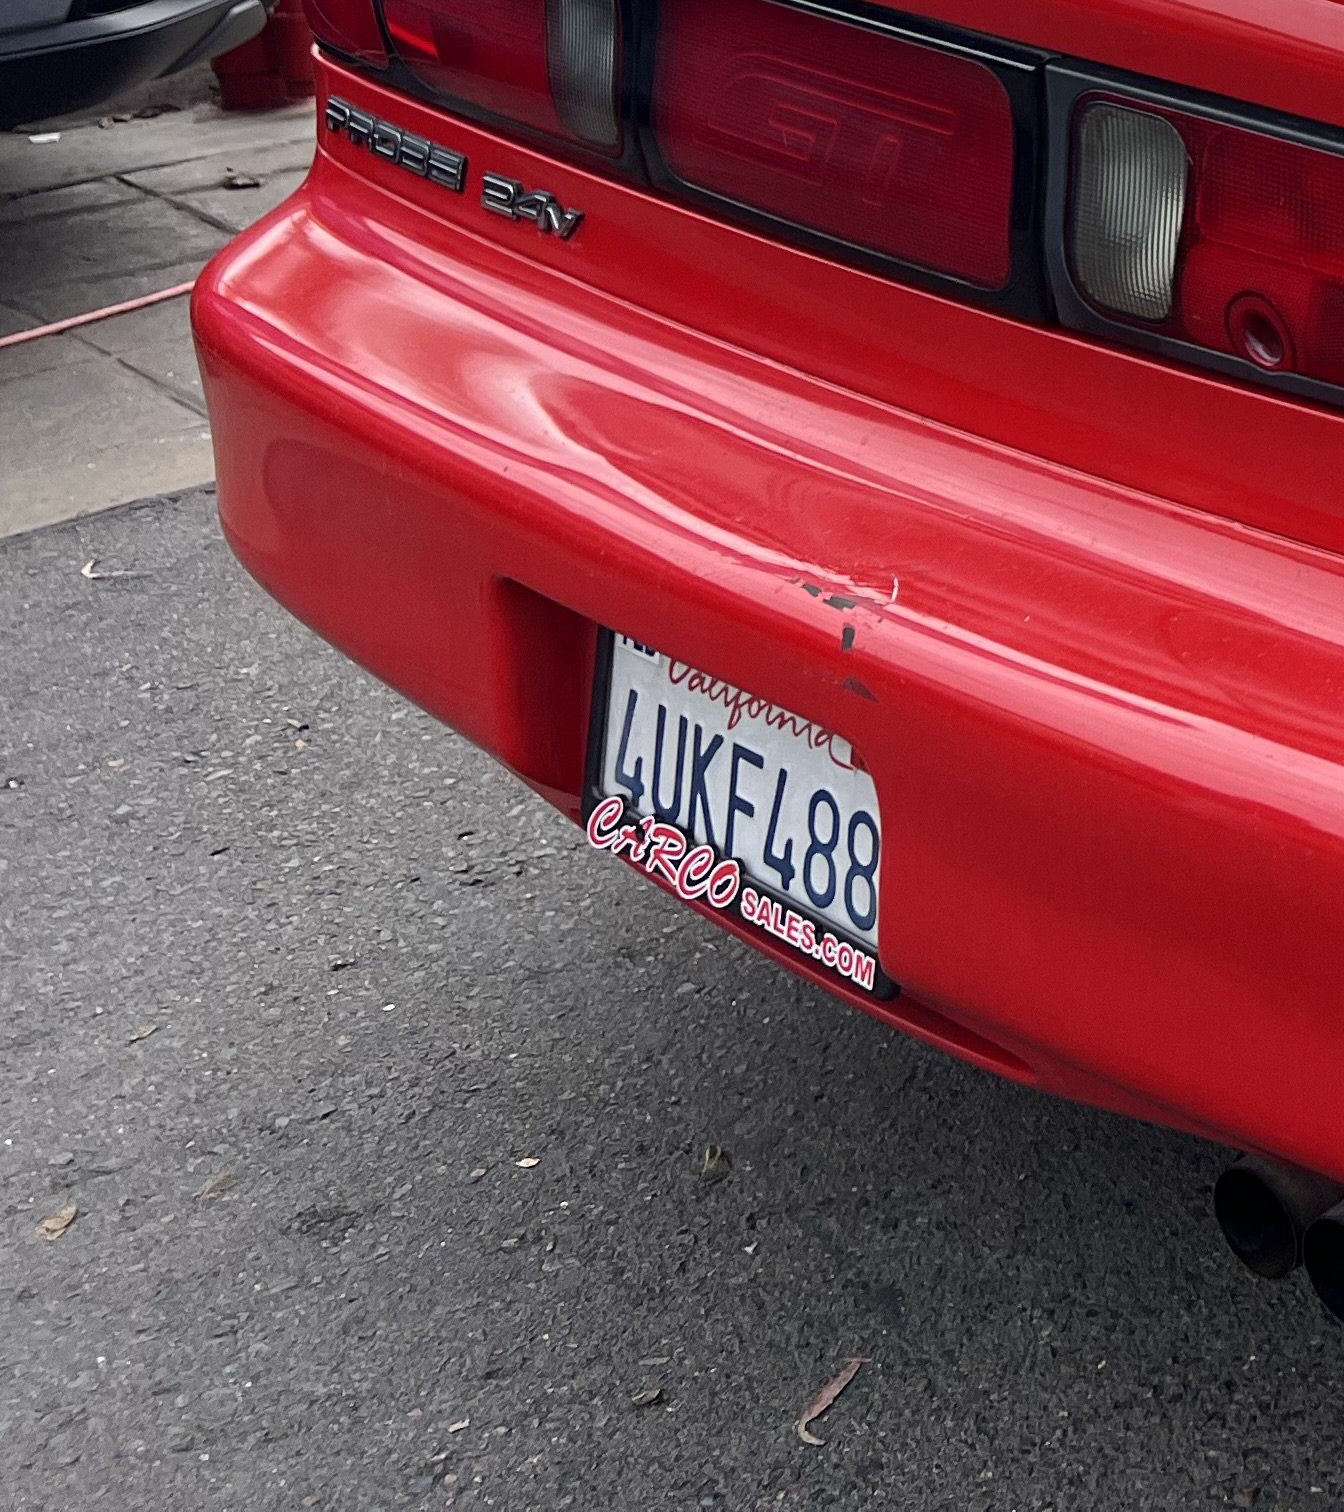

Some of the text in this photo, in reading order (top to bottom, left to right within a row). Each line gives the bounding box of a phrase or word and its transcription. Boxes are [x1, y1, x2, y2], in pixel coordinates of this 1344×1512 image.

[326, 95, 585, 240] PROBE 24V
[698, 53, 958, 207] GT
[587, 797, 876, 989] CARCO SALES.COM
[614, 688, 882, 931] 4UKF488
